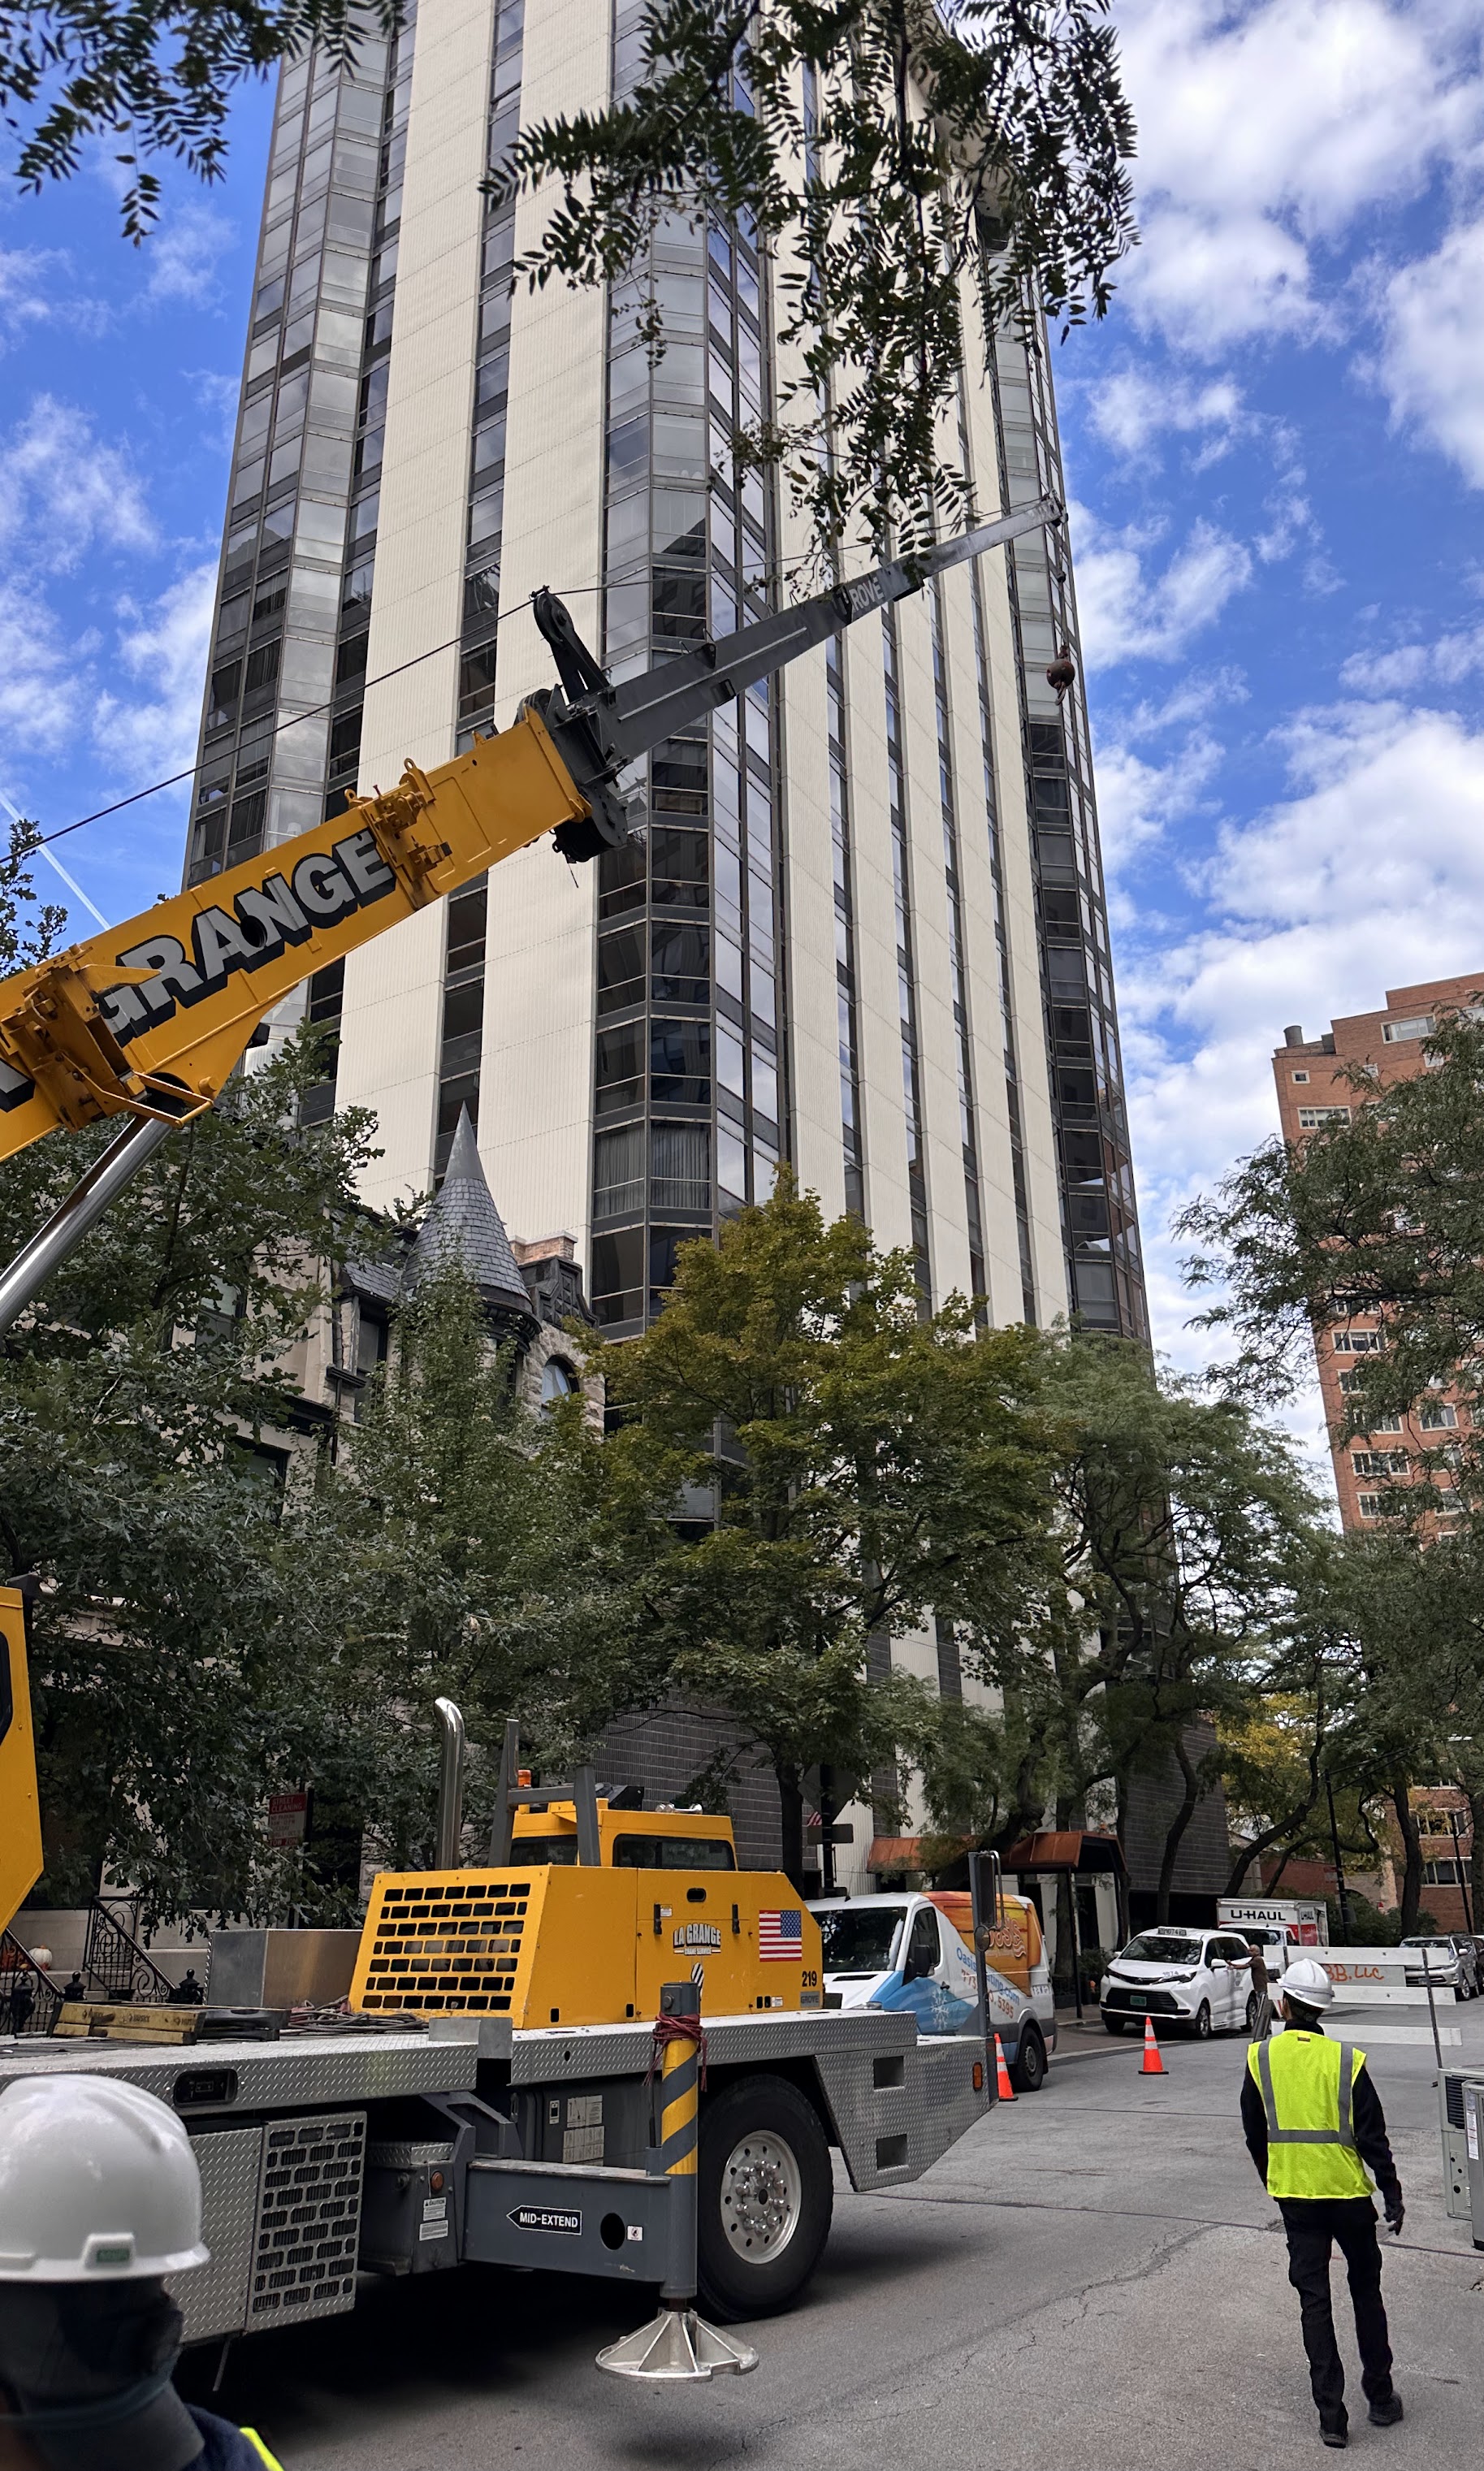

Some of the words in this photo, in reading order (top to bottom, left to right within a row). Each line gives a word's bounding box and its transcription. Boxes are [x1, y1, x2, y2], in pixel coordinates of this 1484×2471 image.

[273, 1797, 294, 1806] STREET
[271, 1803, 302, 1812] CLEANING
[286, 1837, 298, 1846] ZON
[1231, 1910, 1287, 1921] U-HAUL
[673, 1926, 686, 1947] LA
[686, 1923, 721, 1947] GRANGE
[802, 1971, 817, 1987] 219
[956, 1947, 1020, 2006] Oasisating.com
[801, 1995, 820, 2004] GROVE
[520, 2212, 578, 2228] MID-EXTEND
